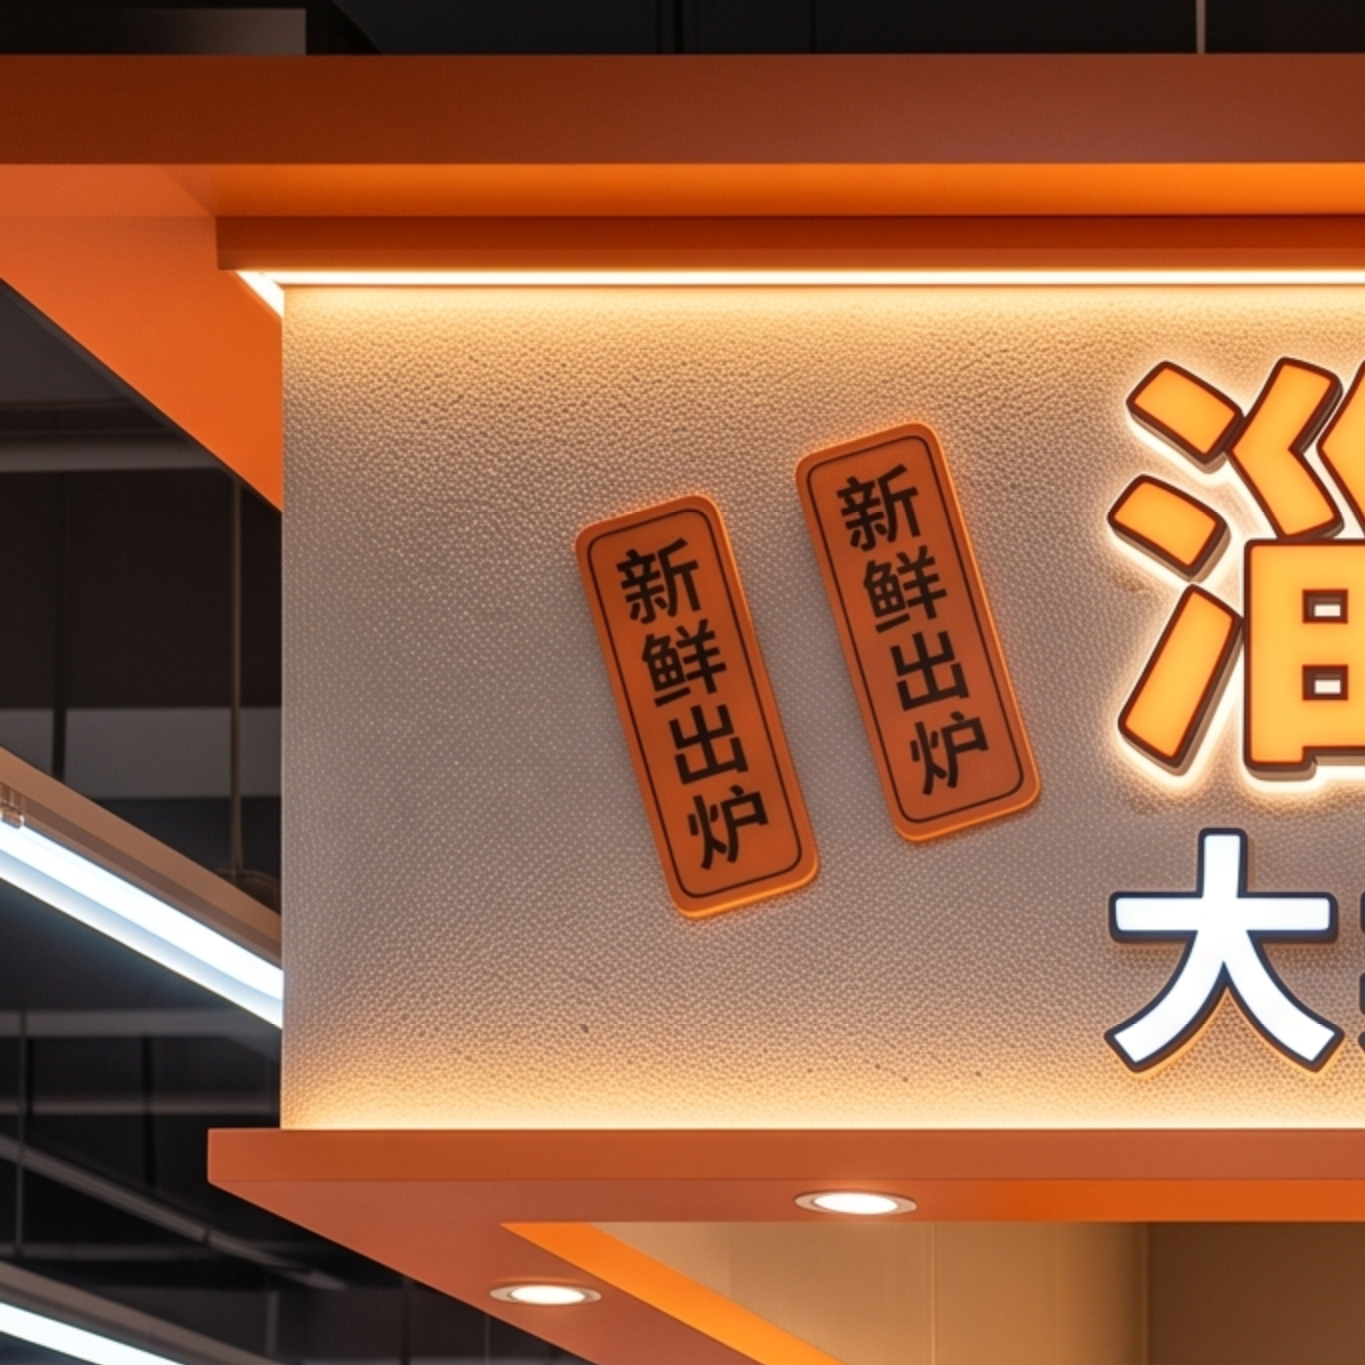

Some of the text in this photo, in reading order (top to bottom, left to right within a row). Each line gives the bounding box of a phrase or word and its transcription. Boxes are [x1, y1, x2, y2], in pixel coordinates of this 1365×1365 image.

[616, 538, 769, 870] 新鲜出炉
[836, 463, 990, 796] 新鲜出炉
